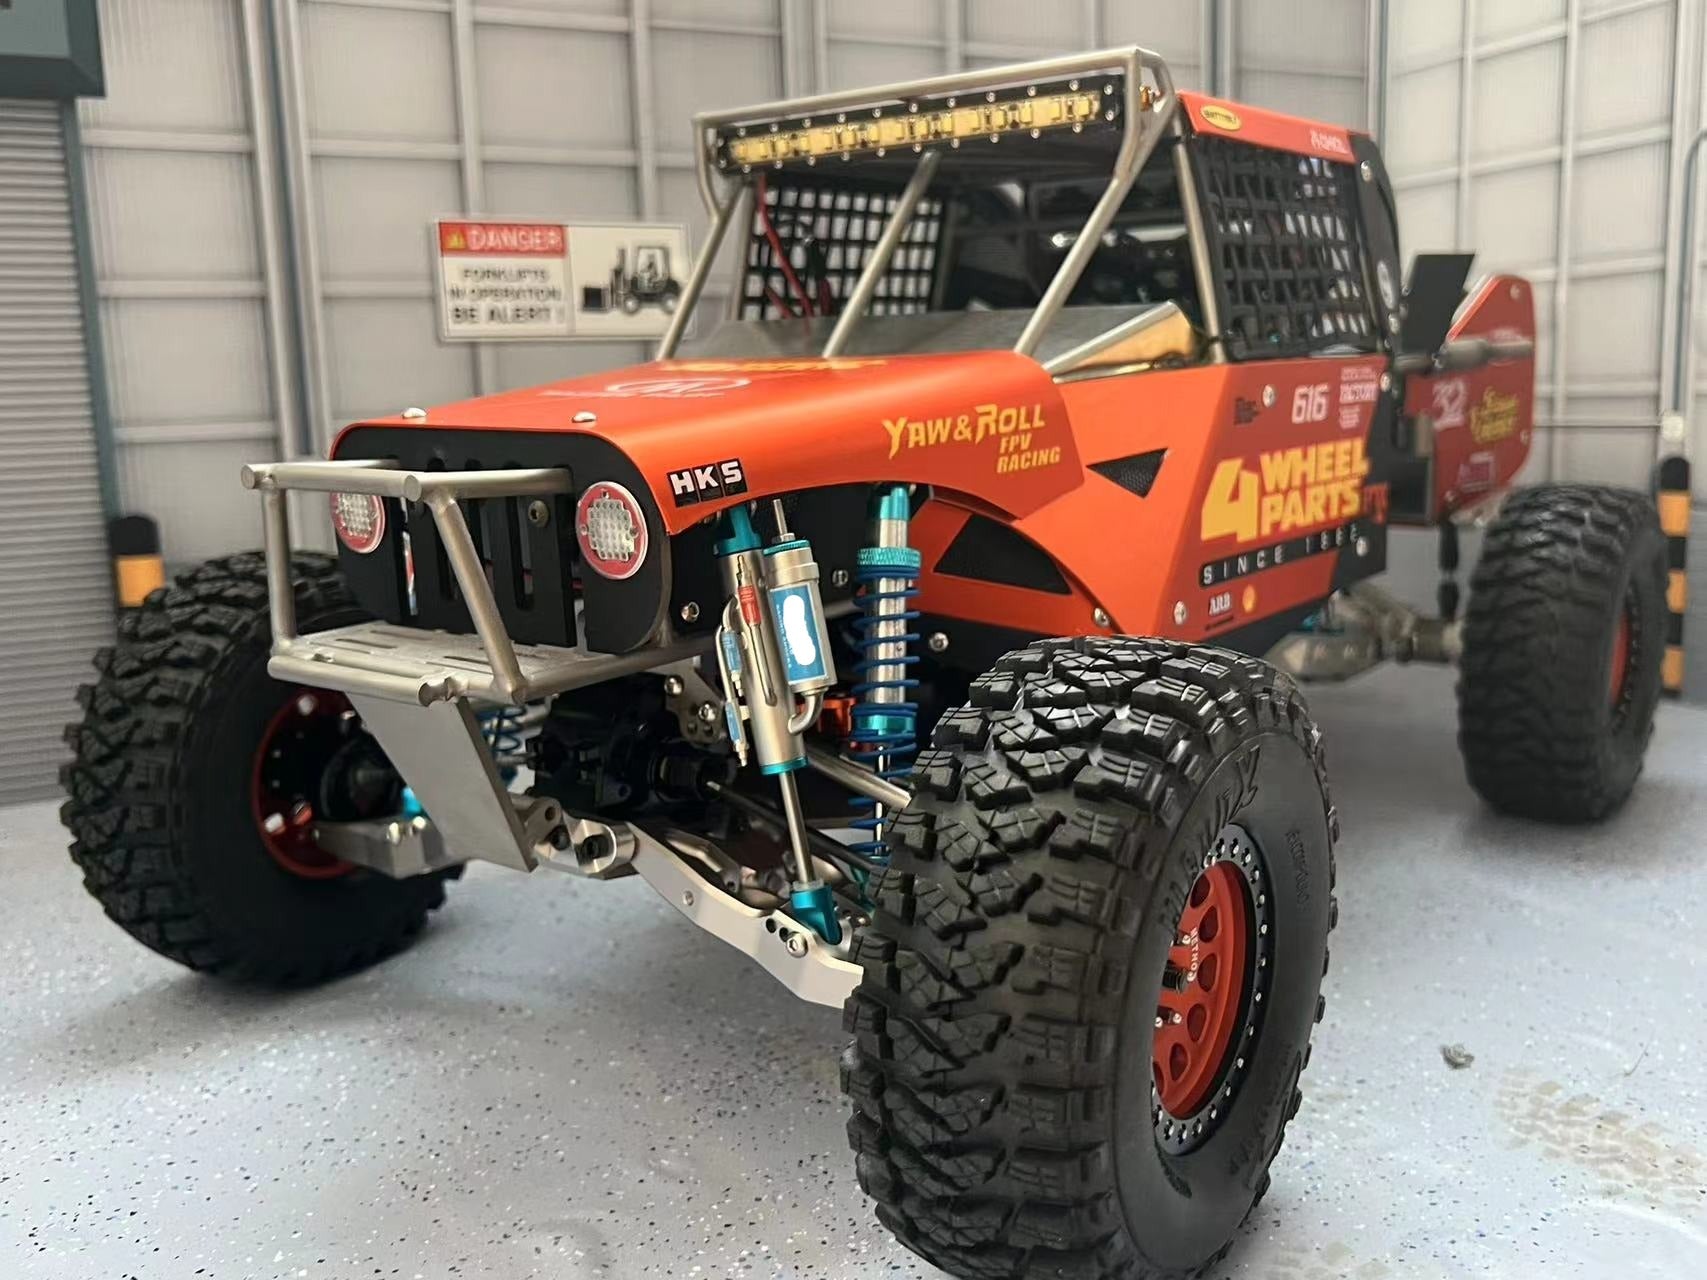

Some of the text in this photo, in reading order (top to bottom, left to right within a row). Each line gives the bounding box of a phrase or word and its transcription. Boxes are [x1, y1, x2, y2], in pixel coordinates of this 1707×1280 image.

[467, 225, 562, 251] DANGER
[452, 305, 479, 323] BE
[1292, 384, 1330, 424] 616
[996, 446, 1062, 474] RACING
[1000, 433, 1033, 454] FPV
[669, 461, 742, 495] HKS
[1260, 436, 1369, 493] WHEEL
[1200, 457, 1258, 543] 4
[1260, 478, 1362, 537] PARTS
[1202, 543, 1285, 585] SINCE
[1208, 591, 1232, 617] ARB
